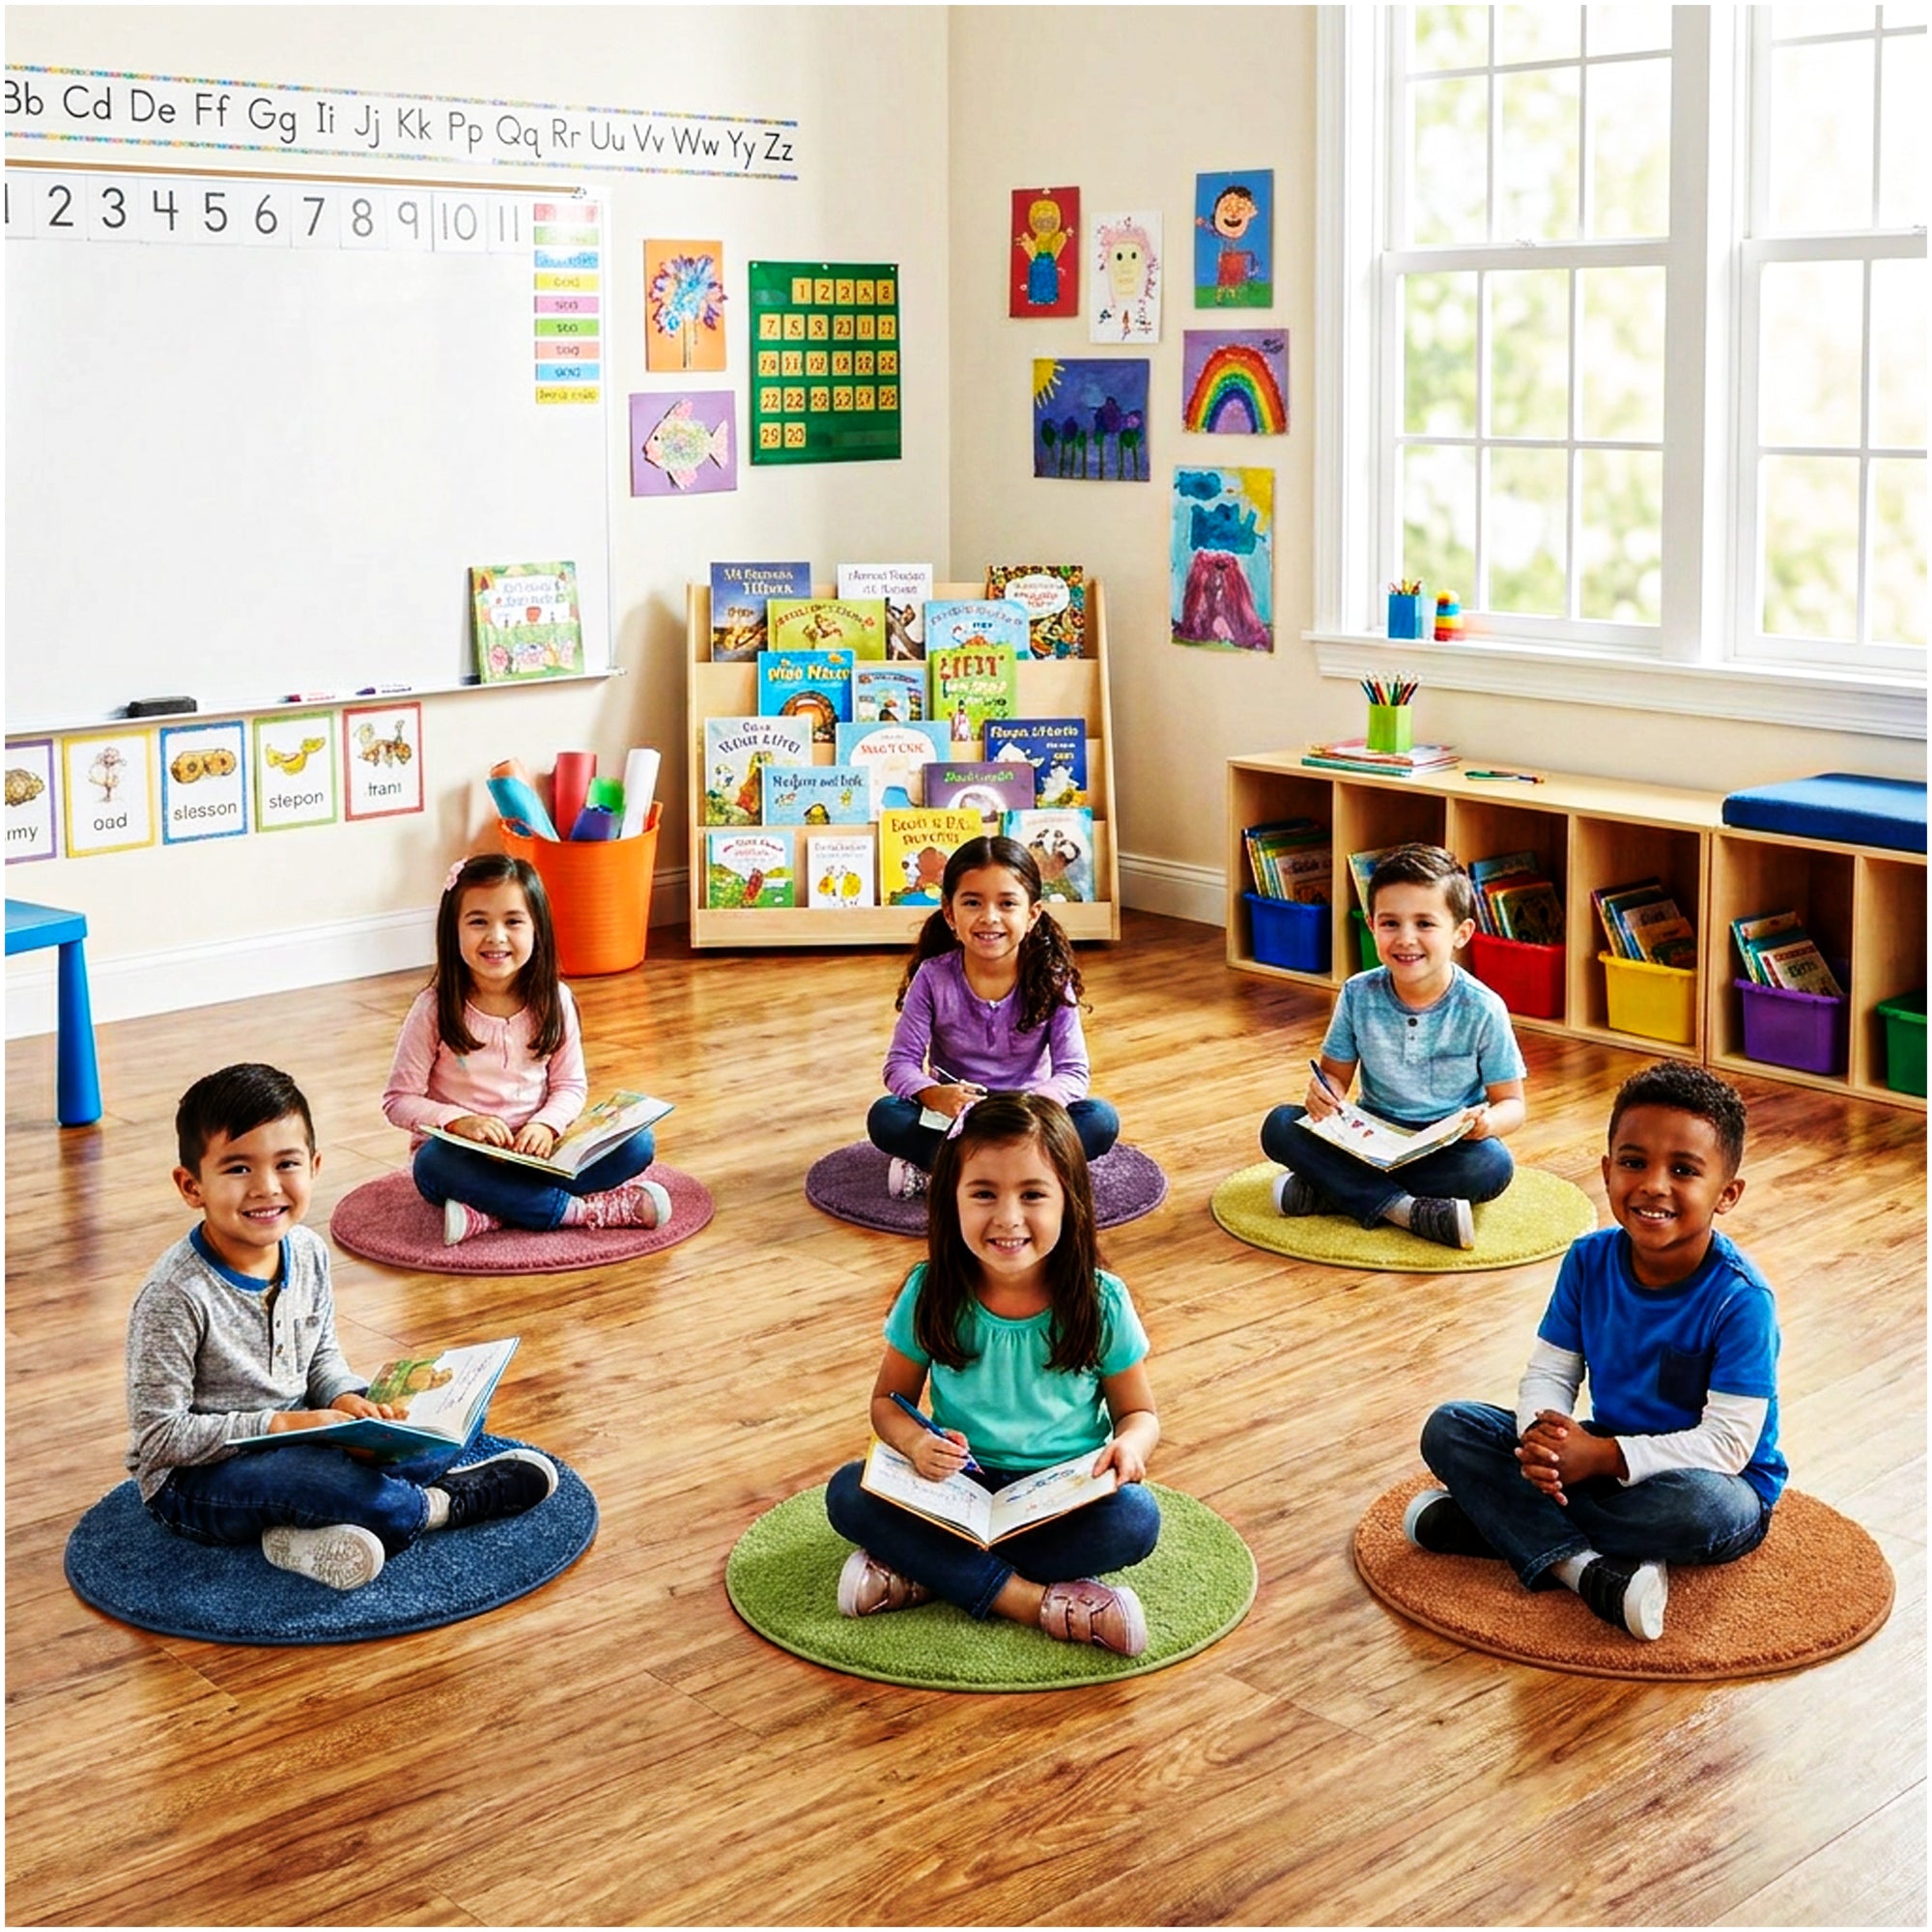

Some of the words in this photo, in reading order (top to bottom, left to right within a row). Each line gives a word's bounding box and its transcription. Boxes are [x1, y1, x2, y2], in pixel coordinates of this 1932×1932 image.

[64, 84, 111, 120] Cd
[130, 89, 176, 124] De
[195, 93, 231, 127] Ff
[248, 98, 297, 144] Gg
[317, 101, 334, 133] Ii
[355, 105, 381, 149] Jj
[398, 108, 432, 140] Kk
[449, 112, 483, 154] Pp
[497, 115, 542, 158] Qq
[553, 118, 582, 149] Rr
[590, 121, 625, 152] Uu
[634, 124, 665, 154] Vv
[672, 127, 720, 156] Ww
[727, 130, 756, 170] Yy
[764, 132, 794, 162] Zz
[47, 185, 74, 227] 2
[101, 186, 127, 228] 3
[153, 190, 179, 231] 4
[204, 192, 228, 232] 5
[255, 194, 278, 235] 6
[302, 197, 326, 236] 7
[352, 198, 374, 237] 8
[398, 201, 419, 240] 9
[442, 202, 477, 241] 10
[499, 205, 519, 242] 11
[269, 789, 324, 810] stepon
